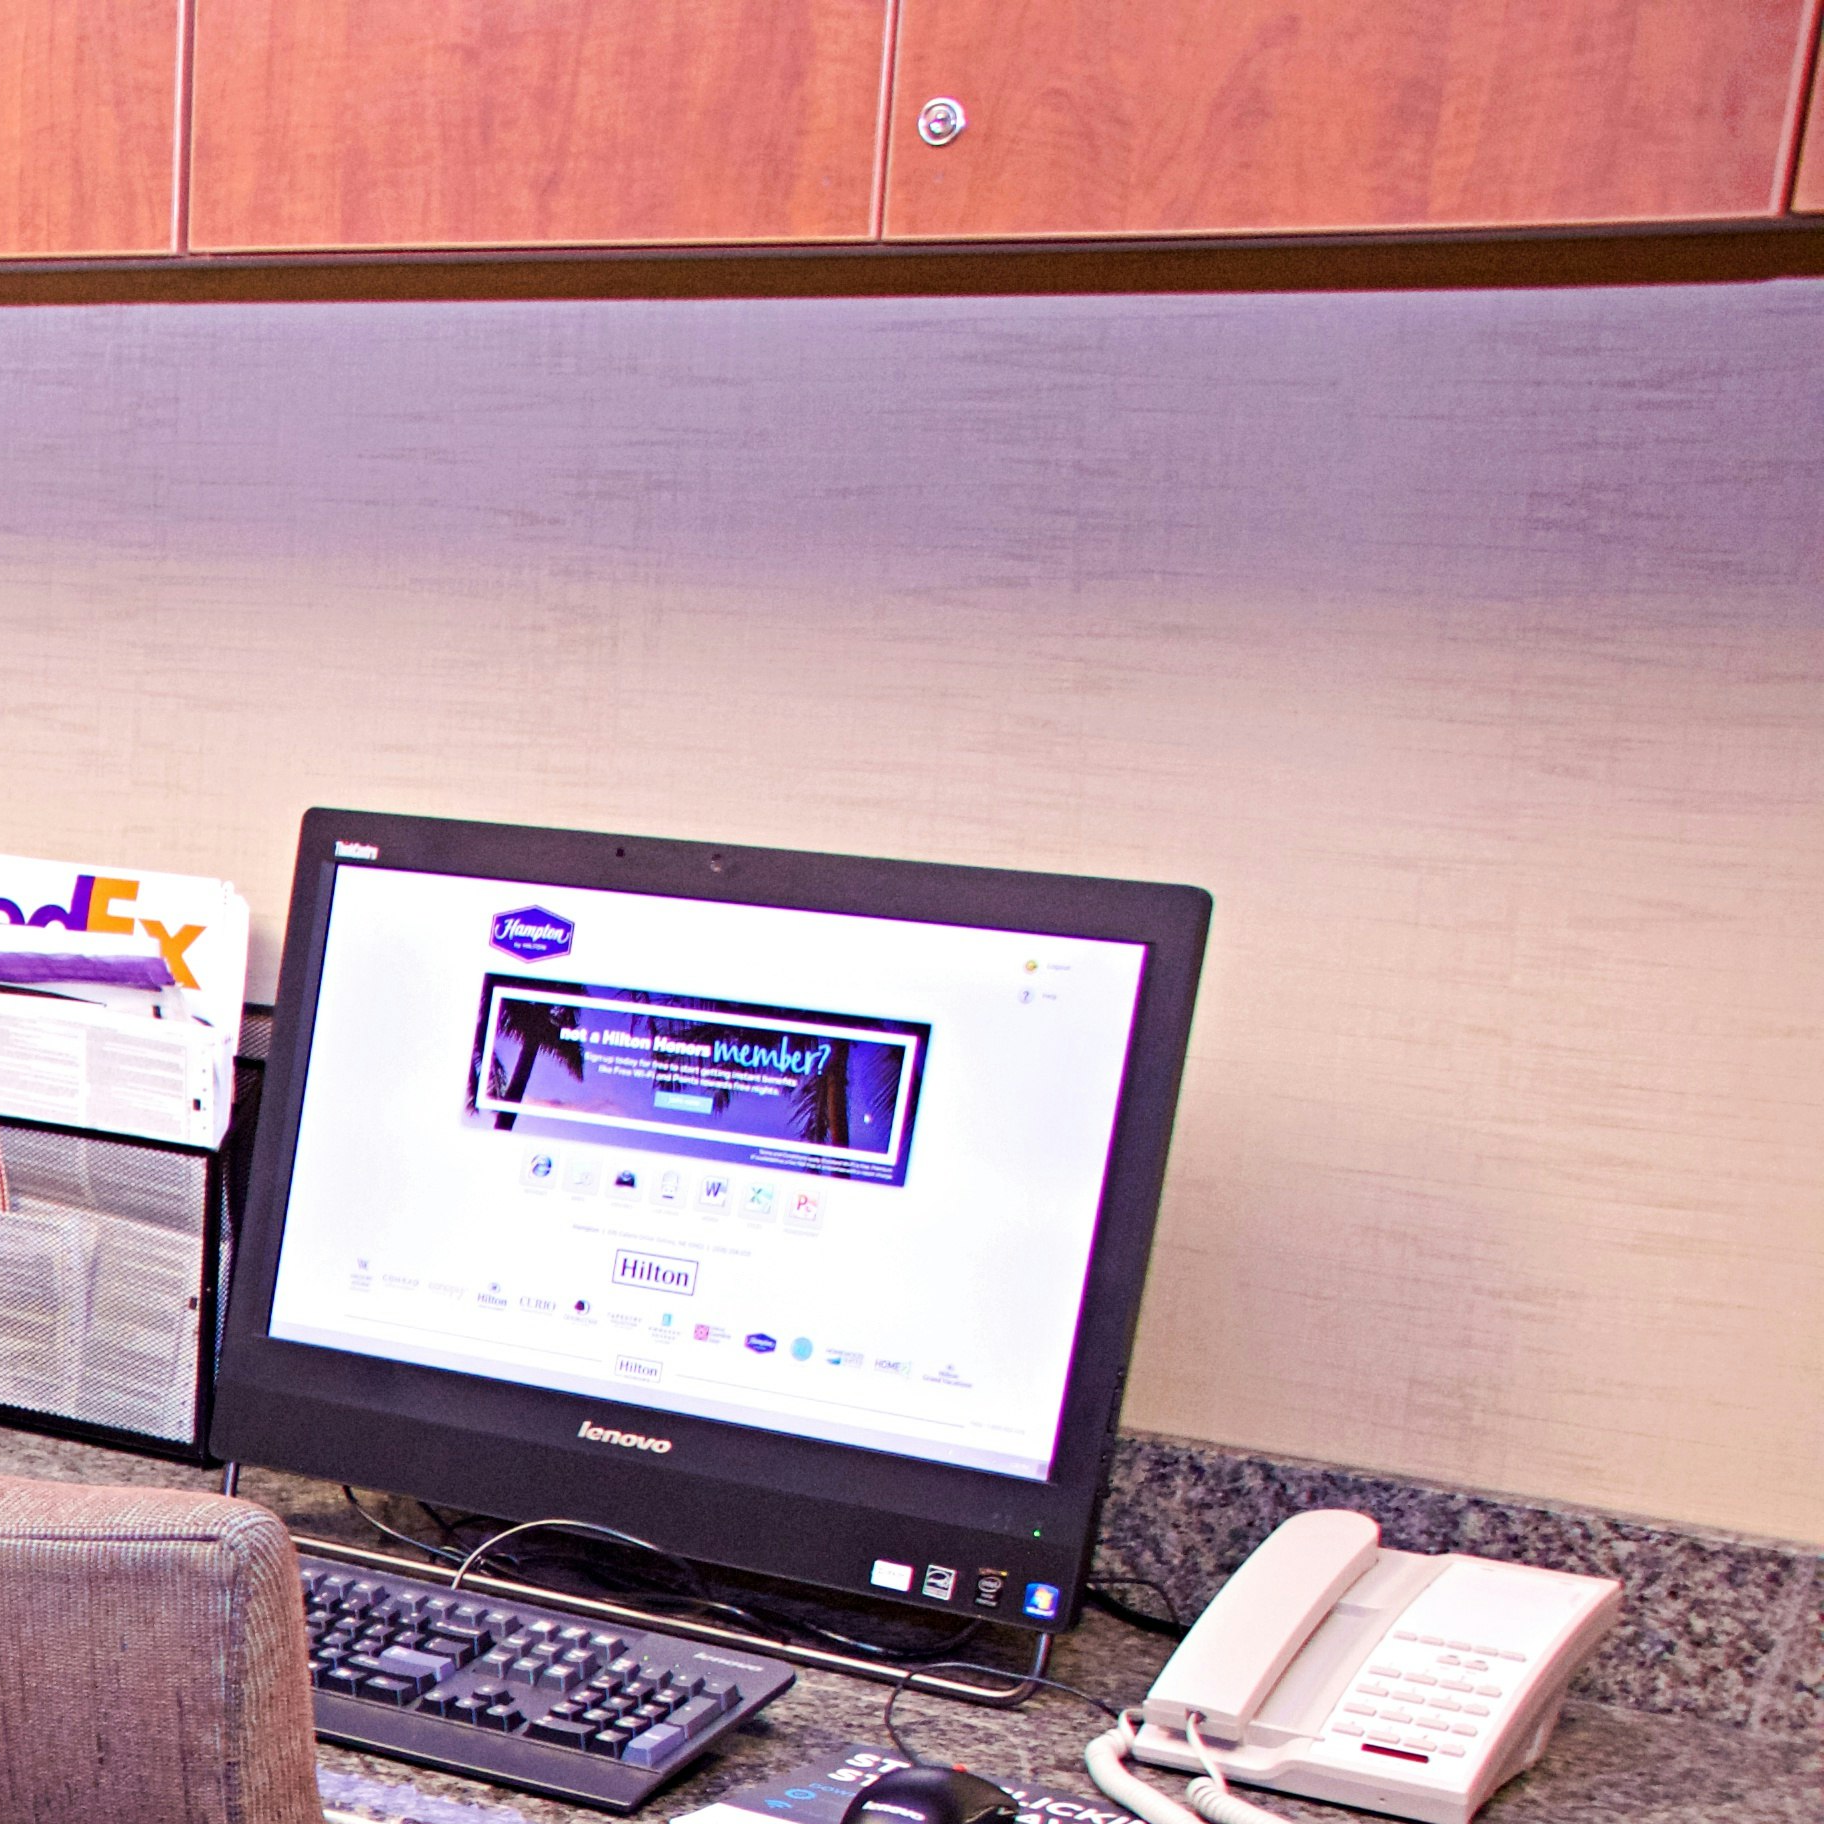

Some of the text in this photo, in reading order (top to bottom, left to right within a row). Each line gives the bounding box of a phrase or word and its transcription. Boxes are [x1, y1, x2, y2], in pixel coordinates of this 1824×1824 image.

[494, 918, 571, 945] Hampton
[560, 1026, 832, 1076] not a Hilton Honors member?
[620, 1257, 689, 1288] Hilton
[477, 1292, 507, 1308] Hilton
[519, 1296, 556, 1312] CURIO
[619, 1360, 658, 1378] Hilton
[577, 1420, 672, 1454] lenovo
[861, 1800, 926, 1821] lenovo
